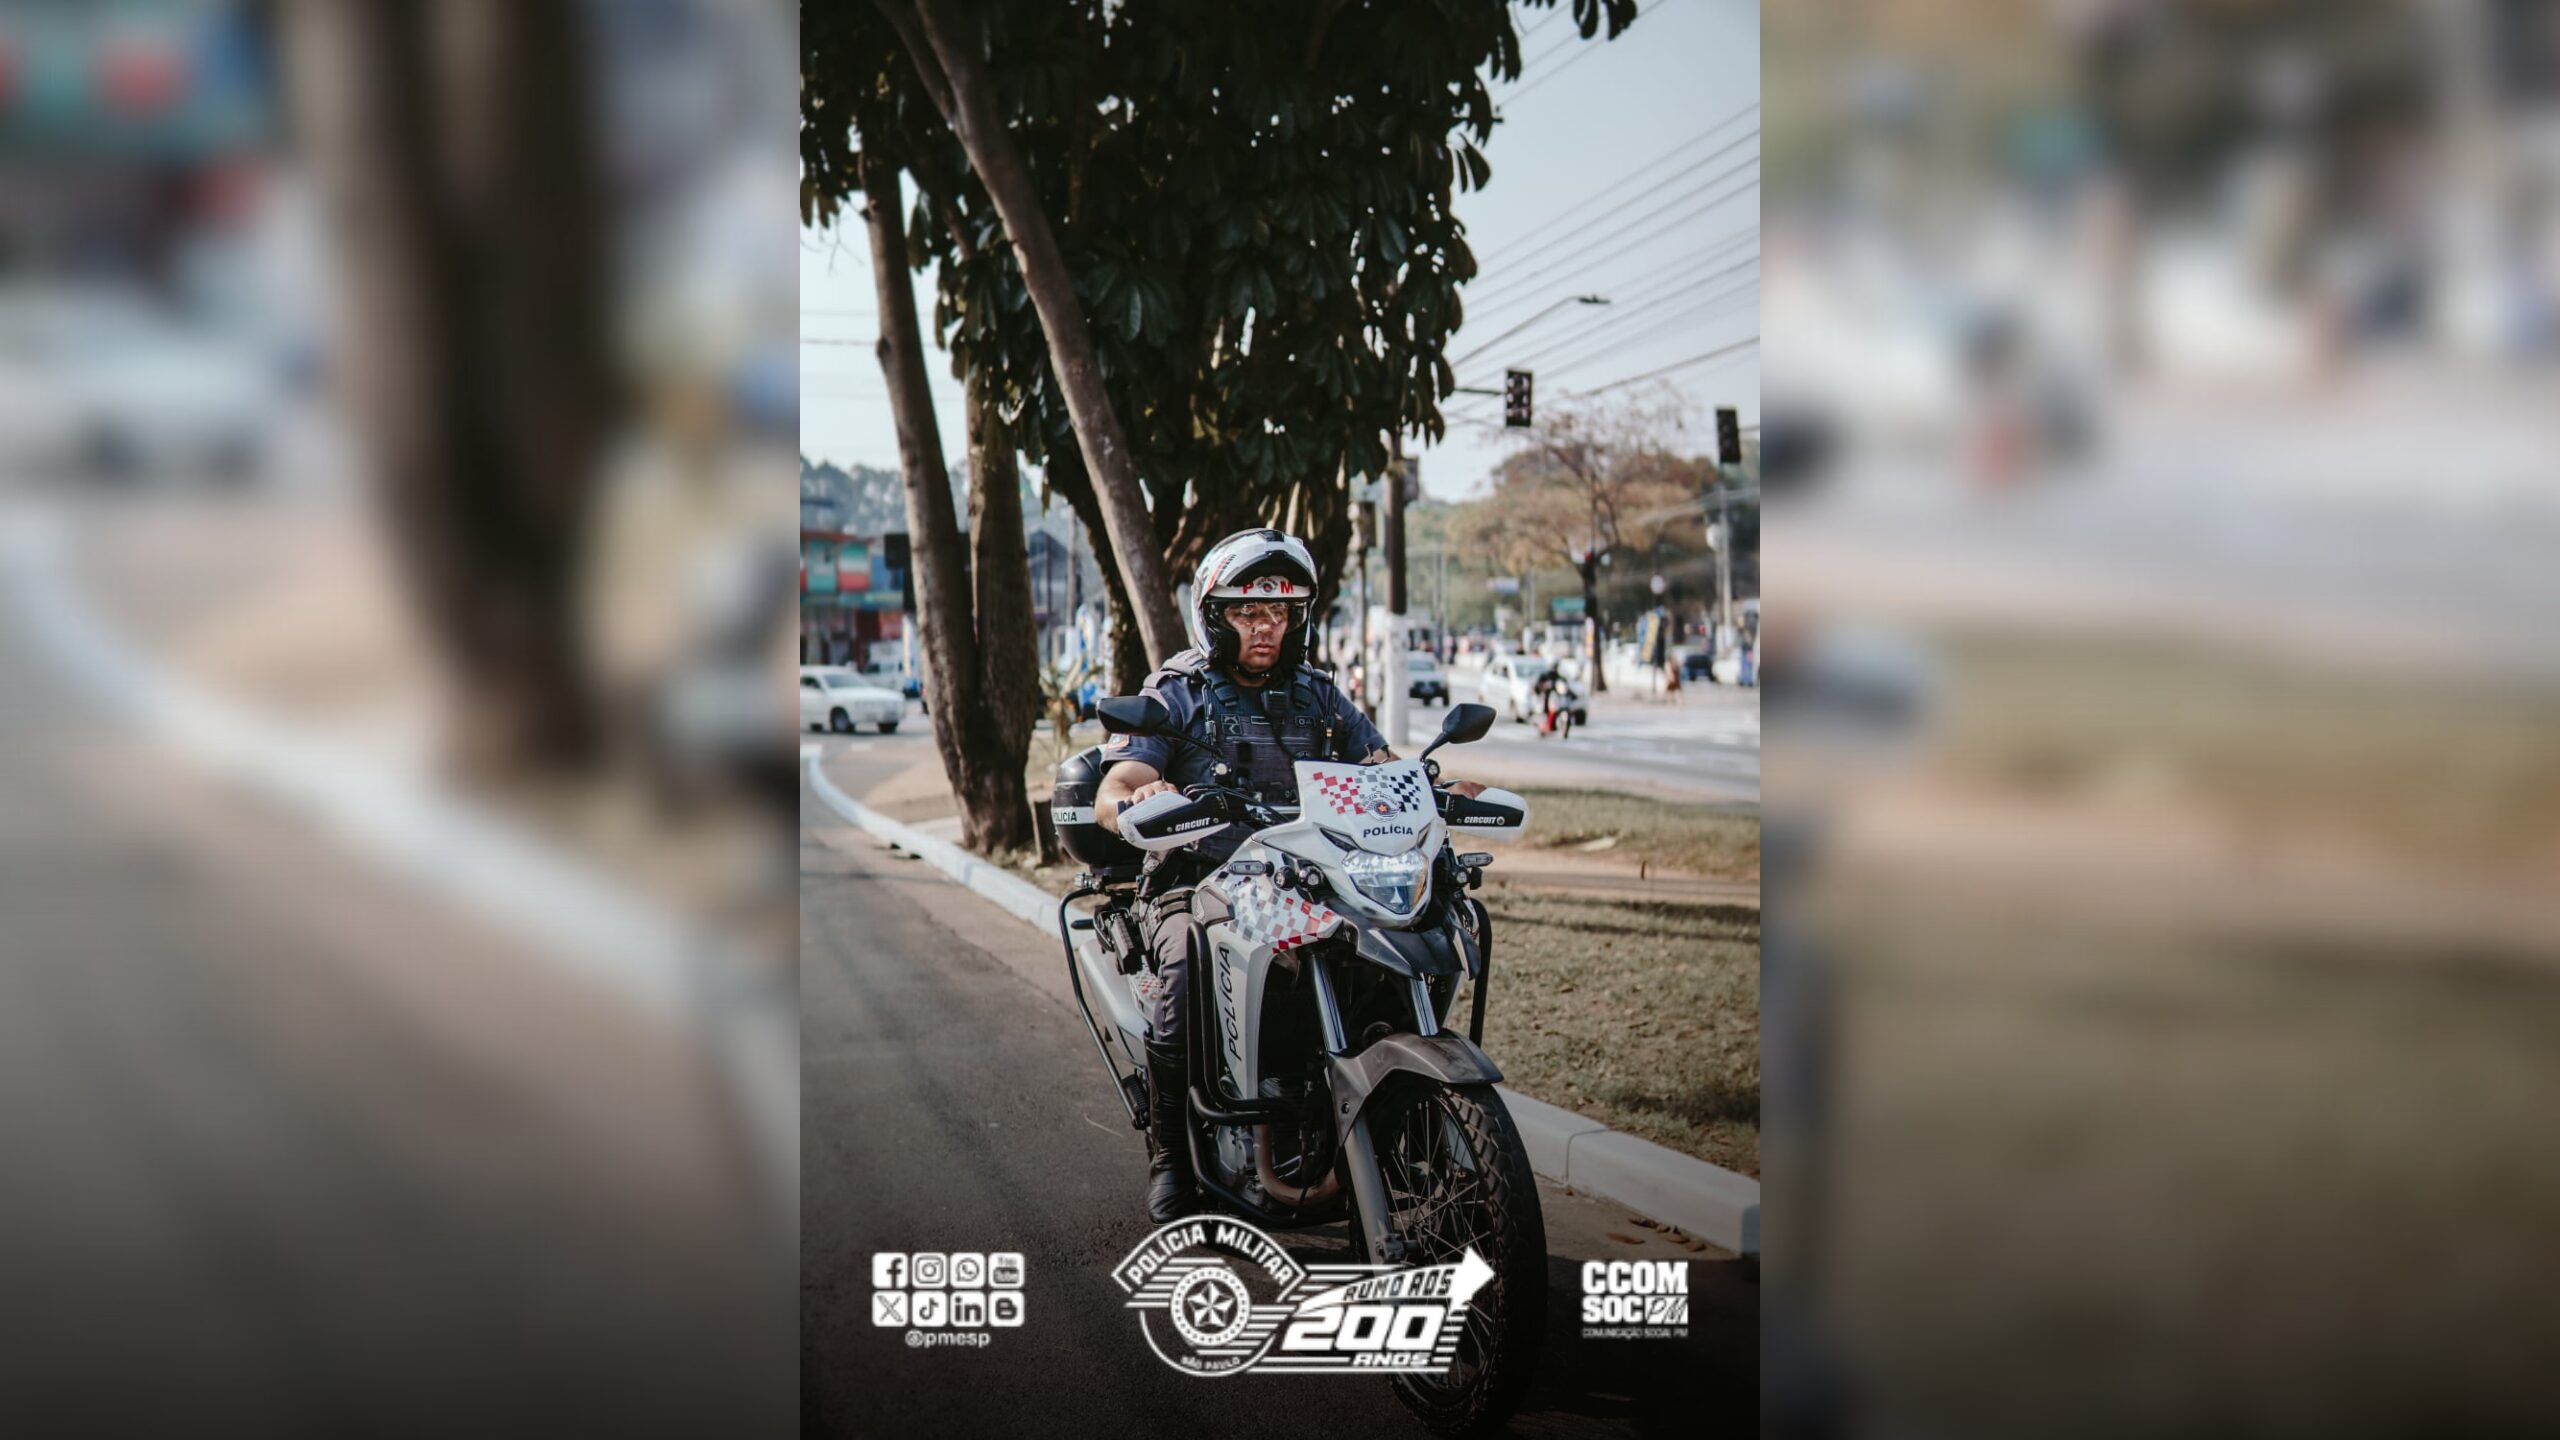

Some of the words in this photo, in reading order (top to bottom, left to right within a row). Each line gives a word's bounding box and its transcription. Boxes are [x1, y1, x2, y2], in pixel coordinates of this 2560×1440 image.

[1243, 581, 1254, 594] P
[1280, 581, 1294, 594] M
[1174, 817, 1211, 832] CIRCUIT
[1464, 816, 1497, 824] CIRCUIT
[1363, 824, 1414, 838] POLÍCIA
